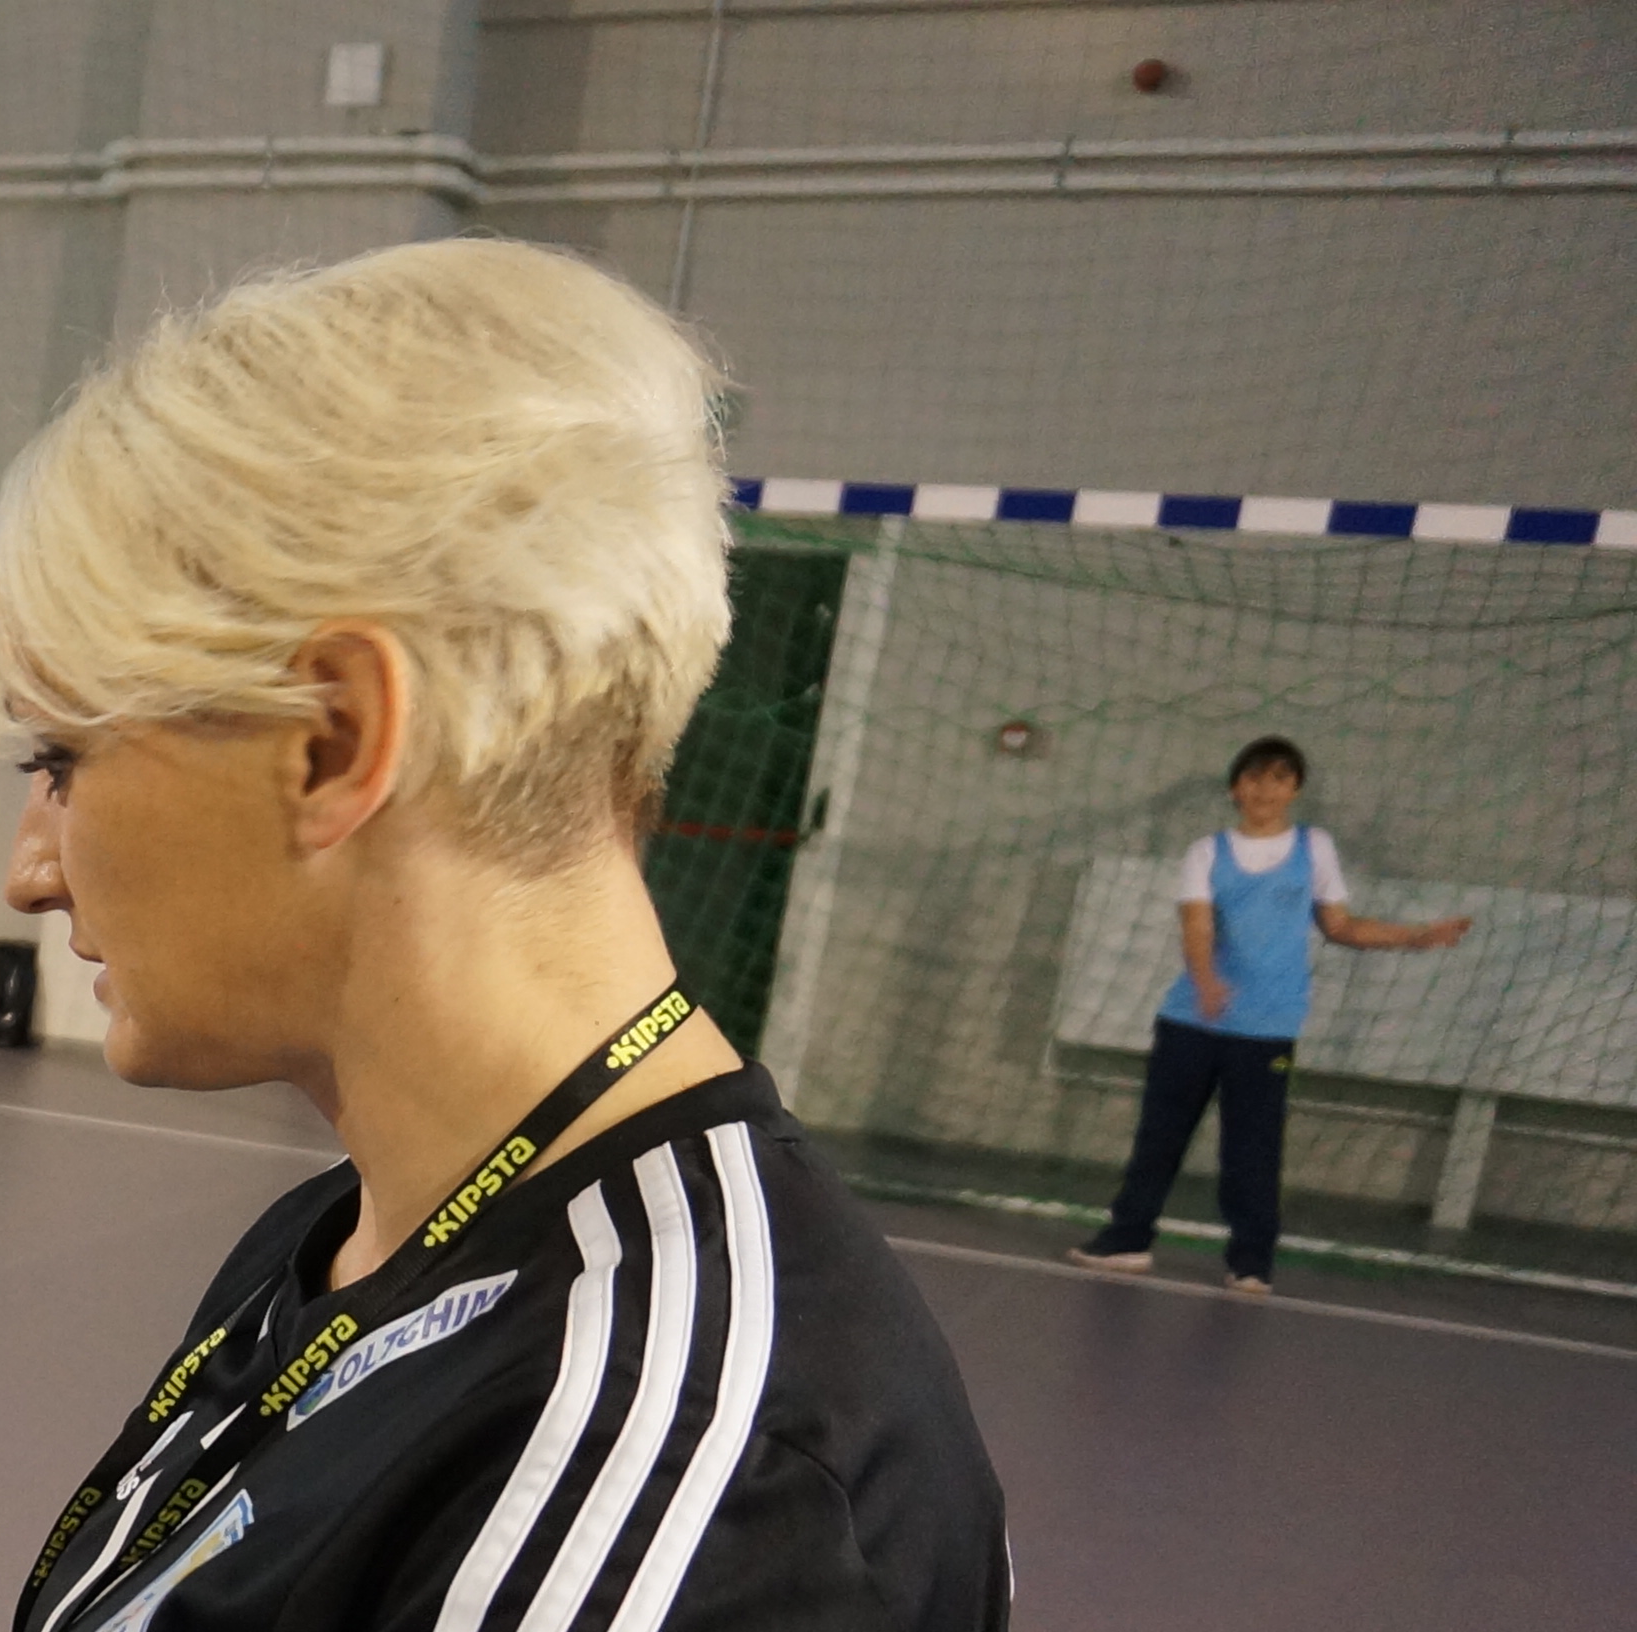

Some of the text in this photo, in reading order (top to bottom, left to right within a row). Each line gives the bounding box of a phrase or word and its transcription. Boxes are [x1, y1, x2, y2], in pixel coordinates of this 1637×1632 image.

[607, 990, 691, 1068] KIPSTA
[424, 1136, 537, 1248] KIPSTA
[259, 1313, 359, 1416] KIPSTA
